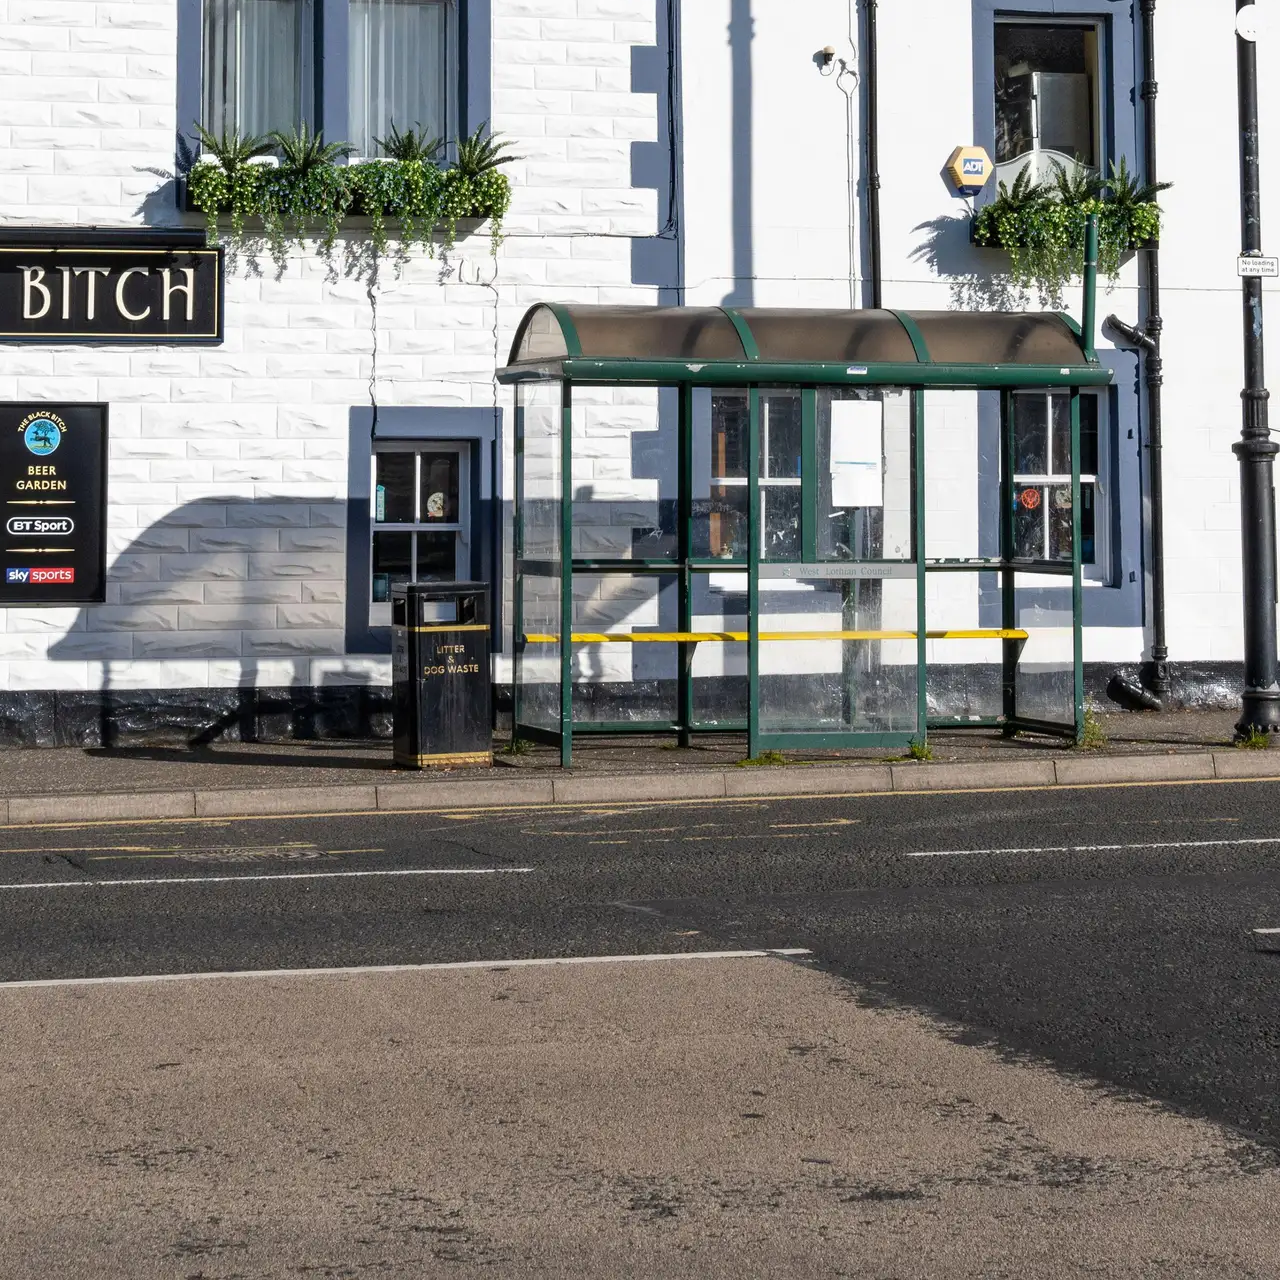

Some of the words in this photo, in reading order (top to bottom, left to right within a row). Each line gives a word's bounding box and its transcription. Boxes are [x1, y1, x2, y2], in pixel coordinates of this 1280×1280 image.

[963, 161, 983, 172] ADT
[1252, 259, 1274, 267] loading
[20, 264, 195, 321] BITCH
[17, 416, 30, 433] THE
[27, 411, 51, 421] BLACK
[50, 413, 68, 433] BITCH
[27, 465, 56, 476] BEER
[16, 480, 67, 490] GARDEN
[13, 520, 33, 531] BT
[34, 520, 68, 532] Sport
[9, 569, 29, 583] sky
[32, 570, 72, 582] sports
[800, 567, 819, 576] West
[825, 567, 857, 576] Lothian
[860, 566, 892, 576] Council
[436, 644, 465, 654] LITTER
[447, 655, 455, 664] &
[424, 665, 445, 675] DOG
[447, 664, 479, 674] WASTE
